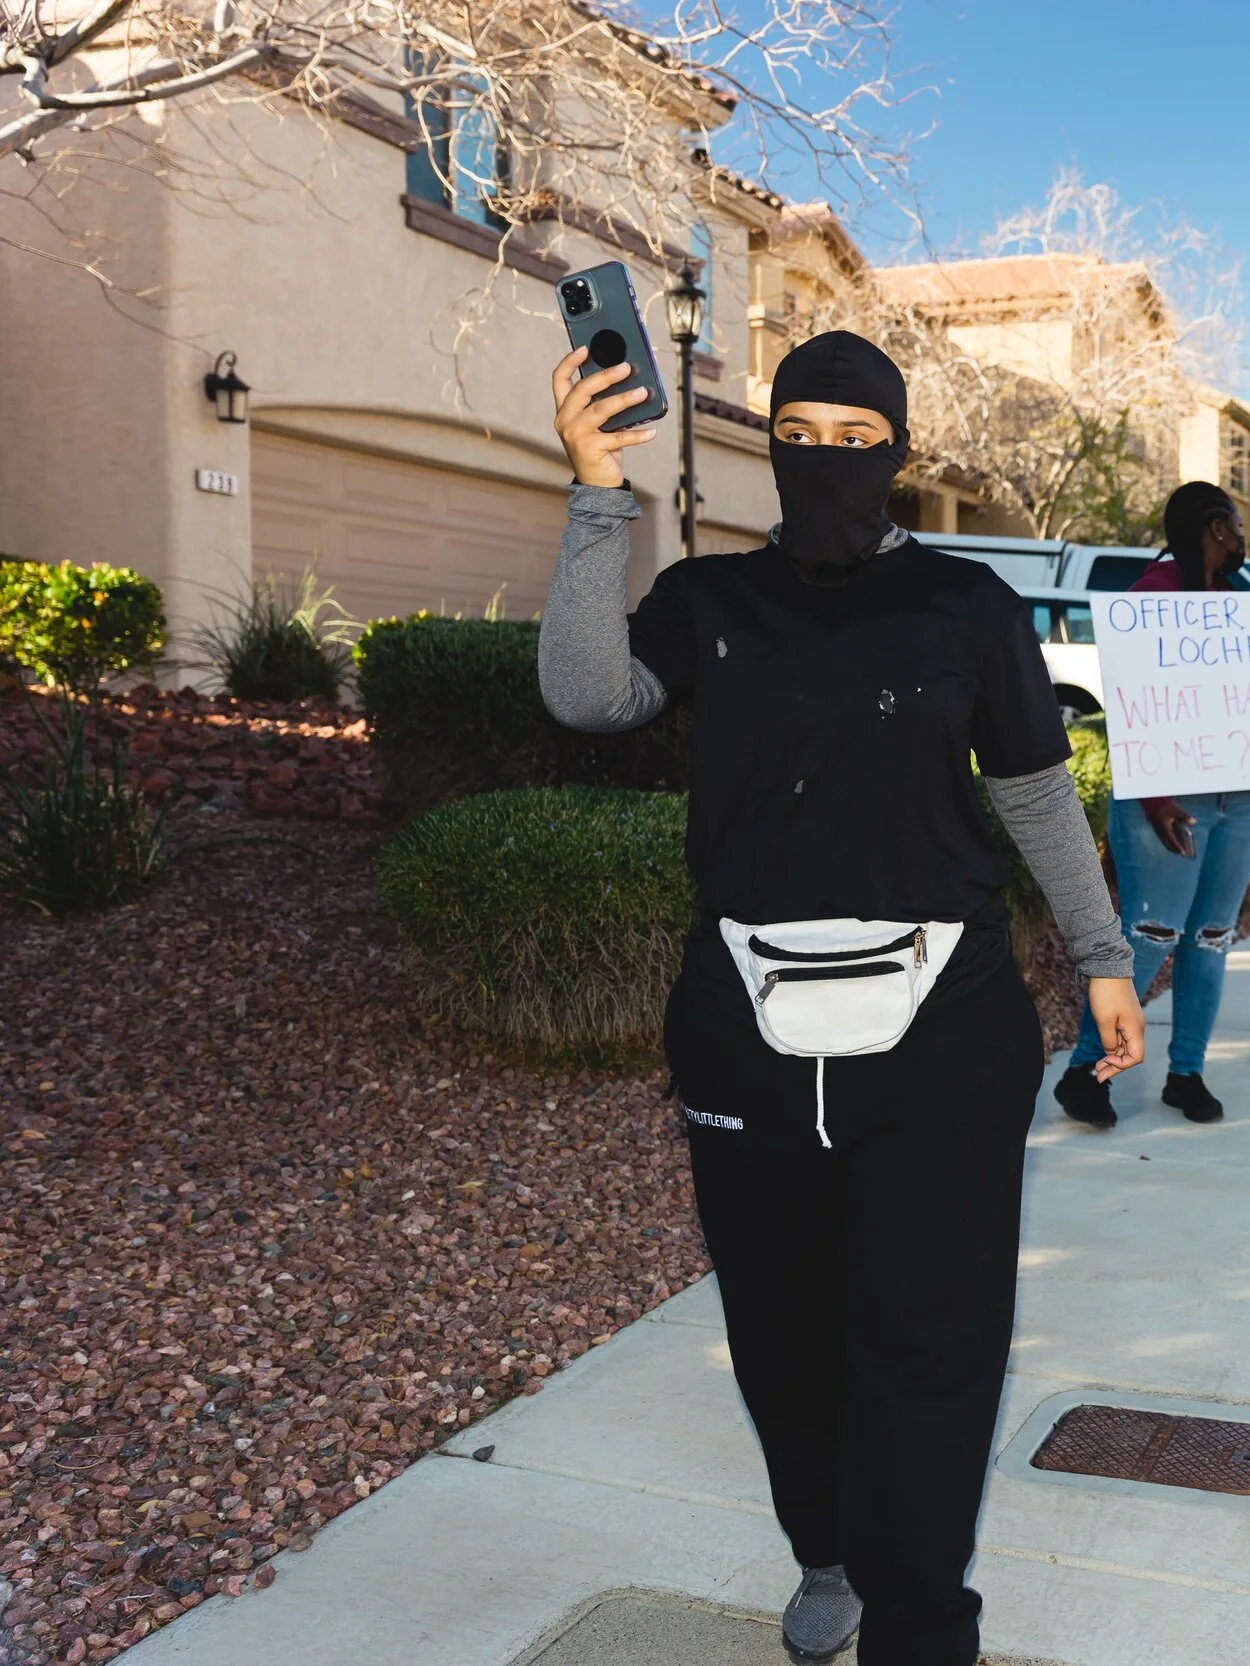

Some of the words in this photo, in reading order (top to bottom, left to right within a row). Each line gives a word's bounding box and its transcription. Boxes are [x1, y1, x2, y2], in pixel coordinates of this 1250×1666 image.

[1109, 597, 1244, 632] OFFICER
[1116, 684, 1204, 729] WHAT
[1112, 740, 1163, 777] TO
